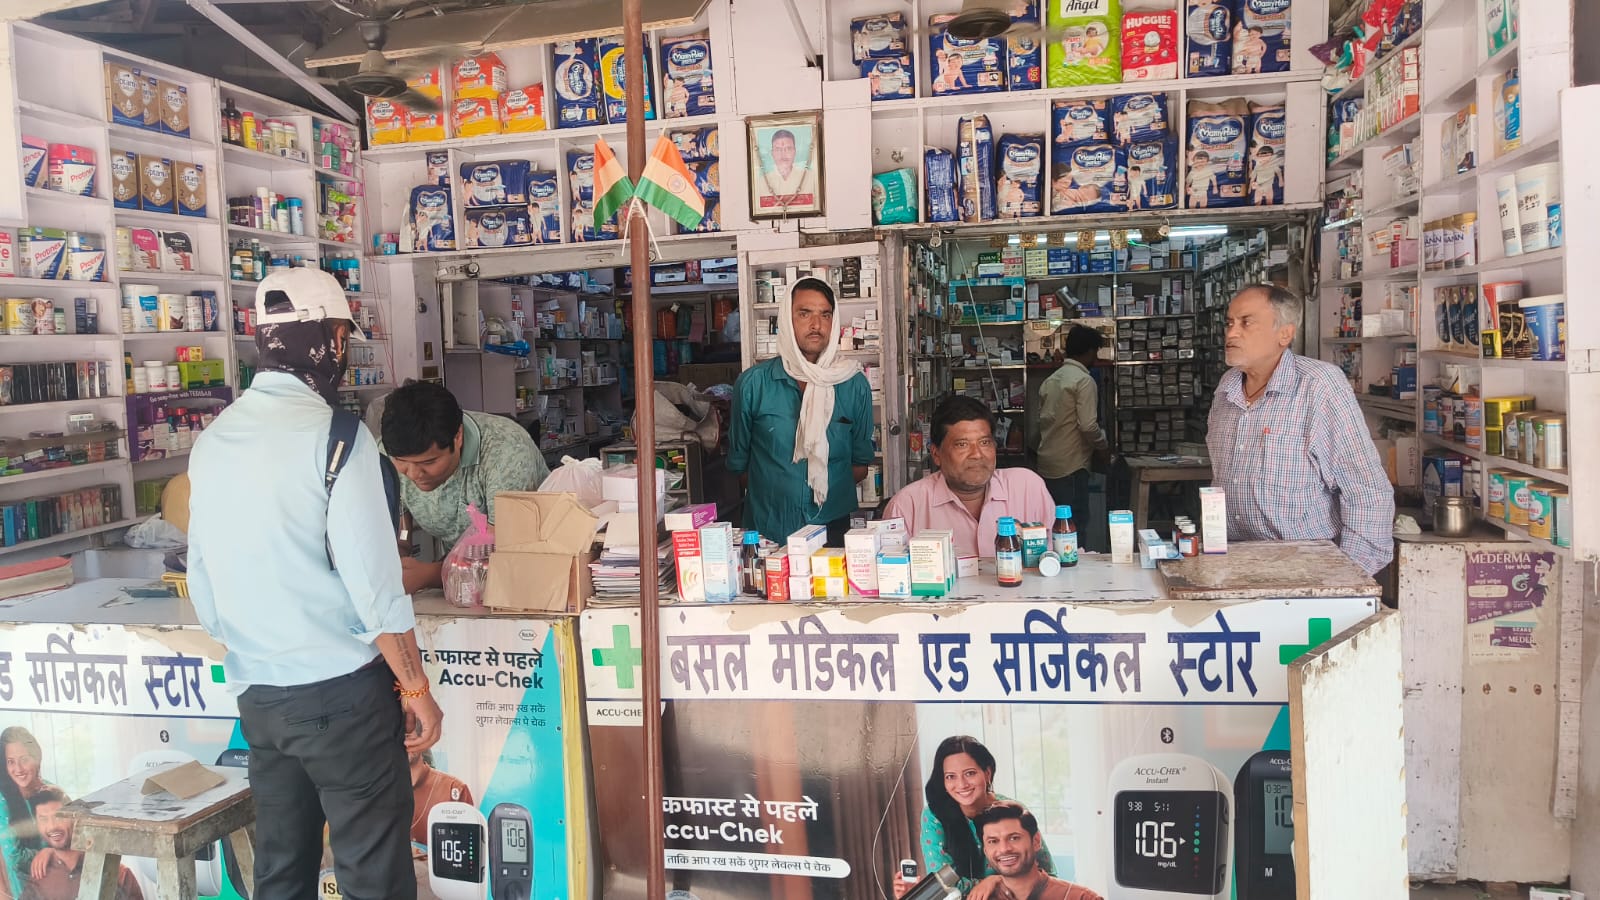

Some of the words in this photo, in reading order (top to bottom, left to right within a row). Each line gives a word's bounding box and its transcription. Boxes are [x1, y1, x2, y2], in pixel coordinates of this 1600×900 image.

[1470, 552, 1531, 564] MEDERMA
[485, 646, 500, 666] से
[503, 647, 544, 669] पहले
[768, 614, 899, 692] मेडिकल
[991, 607, 1146, 695] सर्जिकल
[1168, 610, 1260, 697] स्टोर
[25, 632, 128, 705] सर्जिकल
[439, 668, 544, 689] Accu-Chek
[476, 700, 496, 711] ताकि
[498, 702, 514, 712] आप
[516, 702, 528, 713] रख
[476, 717, 493, 728] शुगर
[523, 716, 529, 727] पे
[531, 717, 546, 727] चेक
[740, 793, 760, 818] से
[764, 795, 819, 822] पहले
[506, 827, 526, 848] 106
[663, 821, 784, 844] ccu-Chek
[1135, 820, 1177, 858] 106
[441, 840, 463, 862] 106
[667, 854, 689, 865] ताकि
[691, 856, 710, 866] आप
[712, 856, 727, 866] रख
[729, 855, 747, 867] सकें
[749, 858, 769, 871] शुगर
[771, 857, 801, 870] लेवल्स
[803, 858, 811, 871] पे
[813, 860, 831, 872] चेक
[1265, 867, 1273, 877] M
